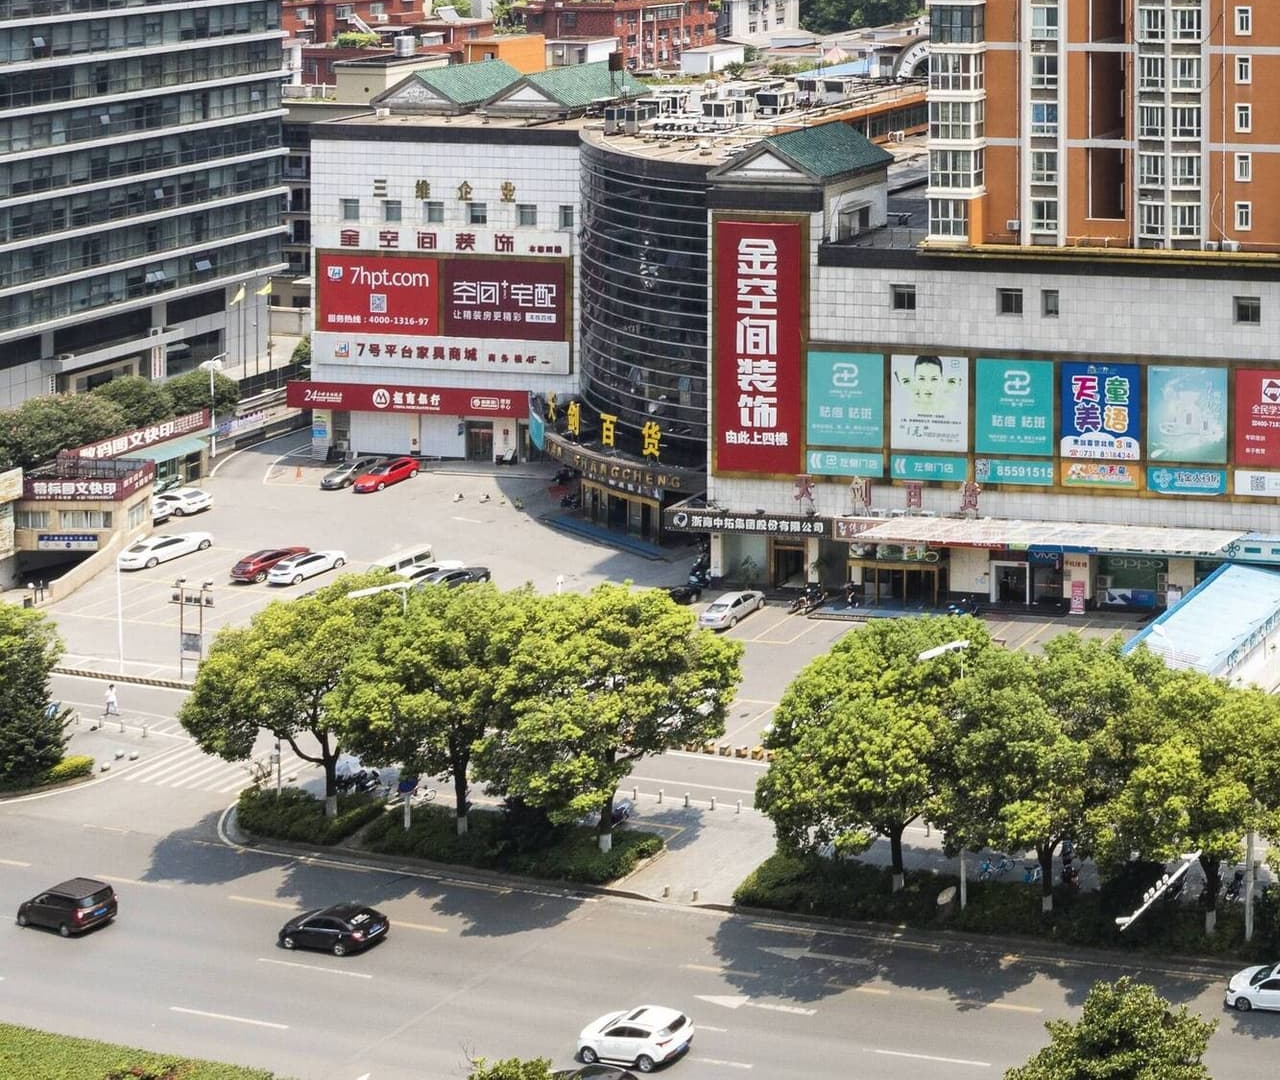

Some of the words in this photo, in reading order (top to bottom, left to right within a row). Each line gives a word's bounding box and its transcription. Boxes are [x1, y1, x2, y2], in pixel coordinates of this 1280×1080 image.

[373, 179, 516, 203] 三维企业
[341, 229, 515, 252] 金空间装饰
[350, 266, 430, 289] 7hpt.com
[453, 311, 522, 323] 让精装房更精彩
[736, 238, 778, 428] 金空间装饰
[356, 343, 478, 362] 7号平台家具商城
[573, 455, 681, 489] SHANGCHENG
[996, 466, 1054, 478] 85591515
[691, 515, 824, 534] 浙商中拓集团股份有限公司
